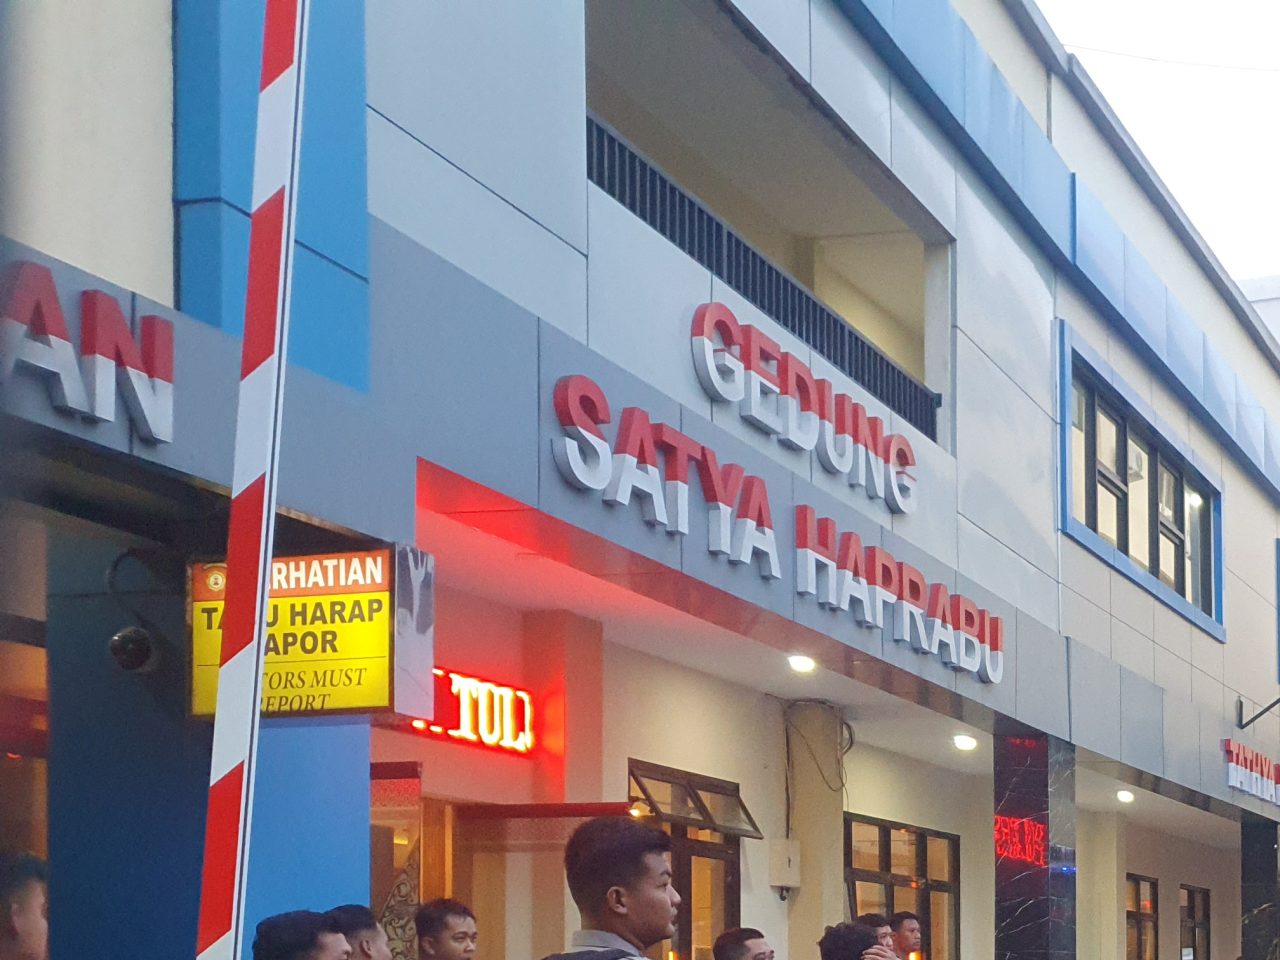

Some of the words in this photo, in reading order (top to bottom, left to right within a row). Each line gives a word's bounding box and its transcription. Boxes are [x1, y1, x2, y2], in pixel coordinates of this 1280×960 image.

[691, 301, 917, 514] GEDUNG
[552, 374, 781, 581] SATYA
[795, 504, 1004, 685] HAPRABU
[270, 556, 382, 591] RHATIAN
[290, 598, 383, 627] HARAP
[264, 630, 338, 657] APOR
[310, 668, 367, 688] MUST
